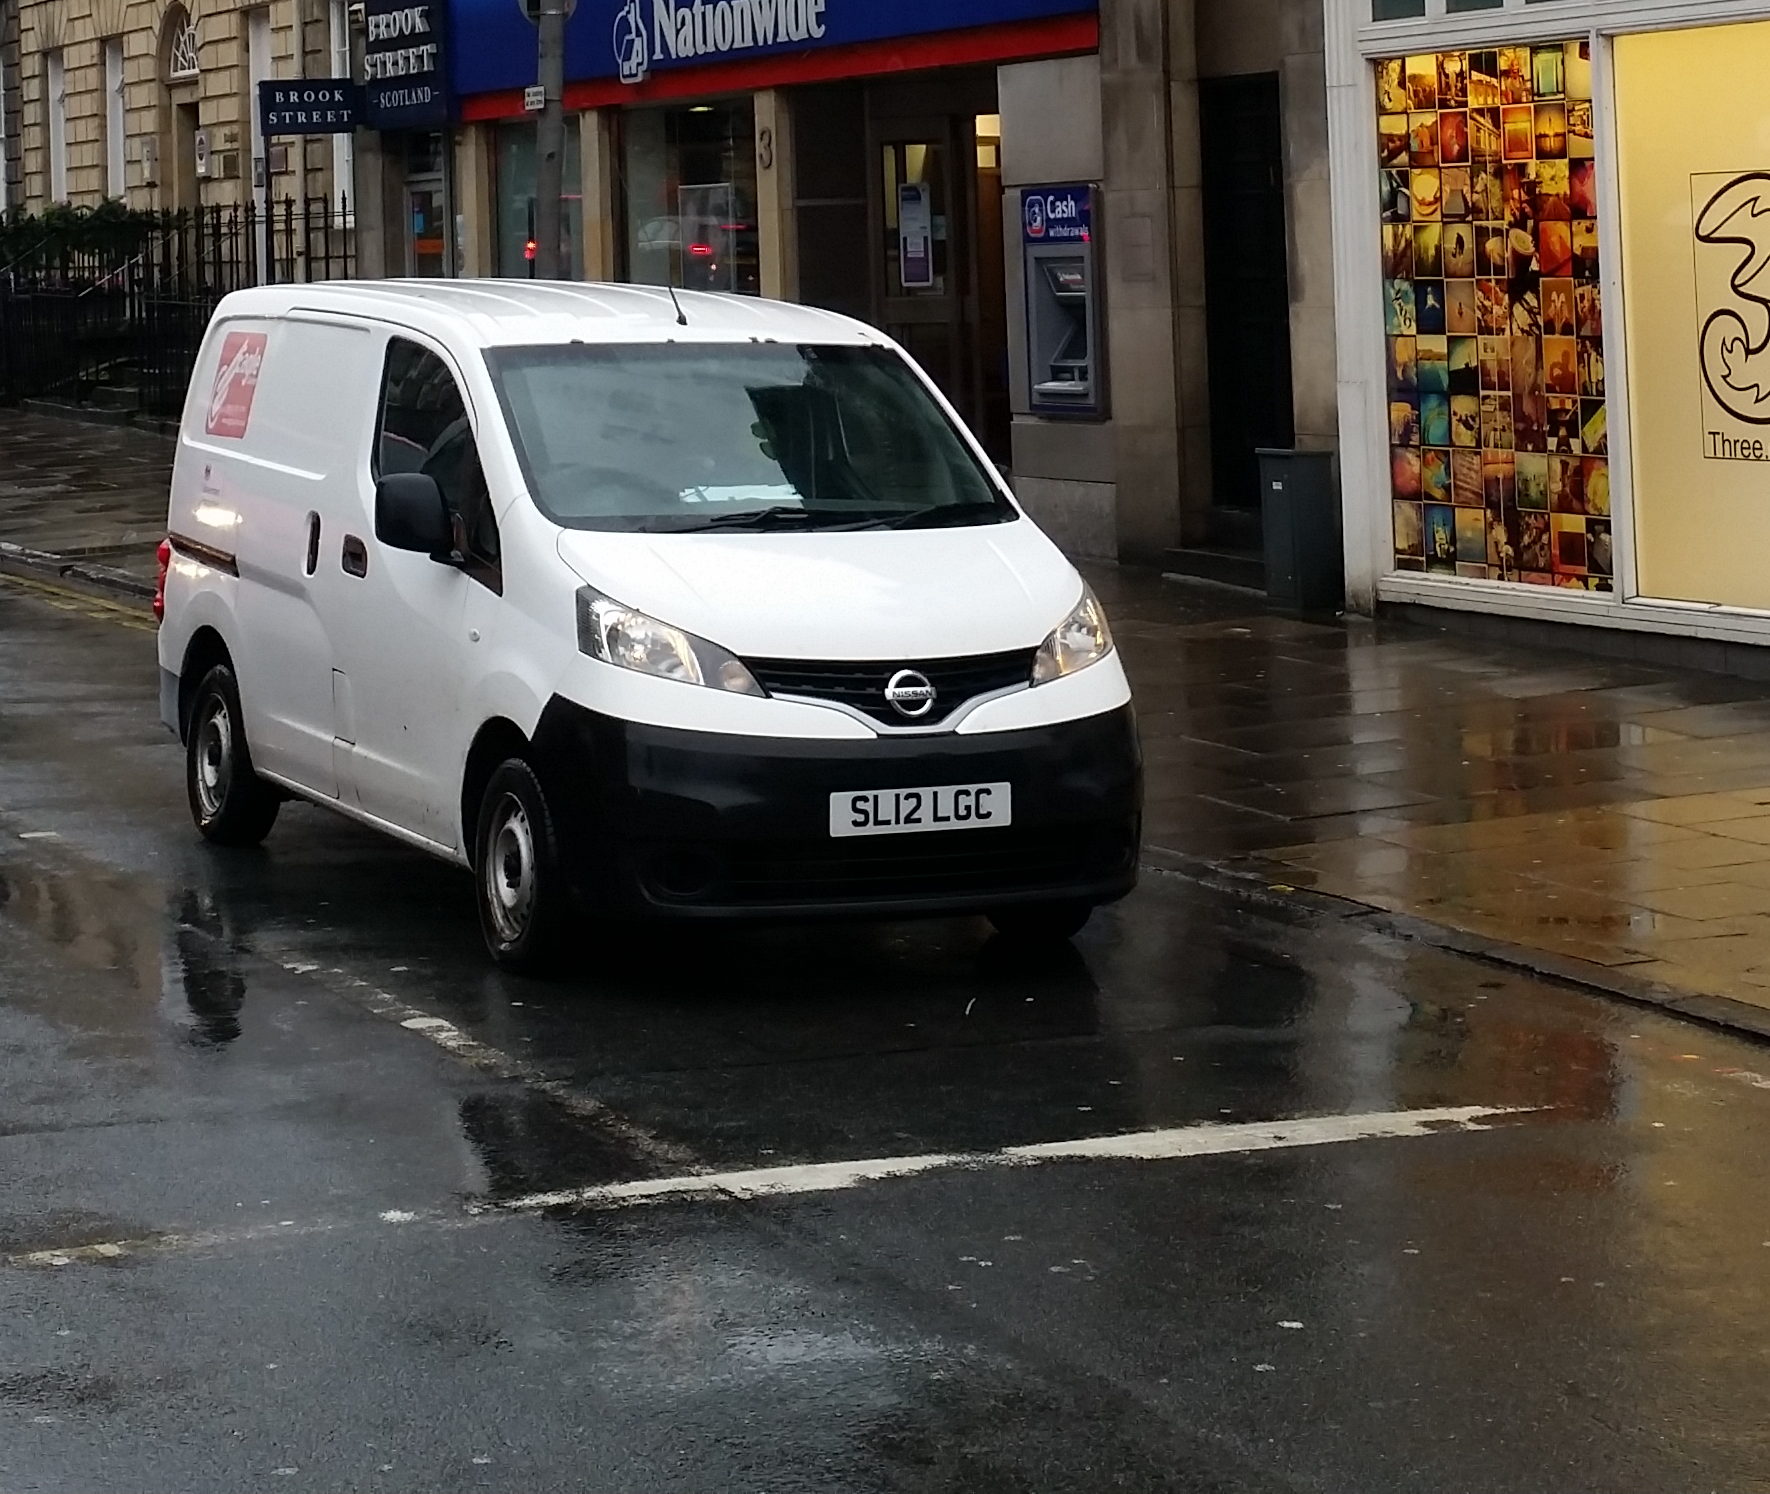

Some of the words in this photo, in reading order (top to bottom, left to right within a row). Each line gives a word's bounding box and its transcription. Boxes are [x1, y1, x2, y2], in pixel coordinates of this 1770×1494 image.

[367, 5, 431, 42] BROOK
[363, 42, 437, 81] STREET
[274, 89, 345, 103] BROOK
[267, 109, 353, 124] STREET
[758, 126, 773, 170] 3
[1047, 194, 1076, 219] Cash
[1049, 223, 1089, 237] withdrawals
[892, 689, 933, 698] NISSAN
[850, 792, 923, 828] SL12
[932, 787, 993, 823] LGC
